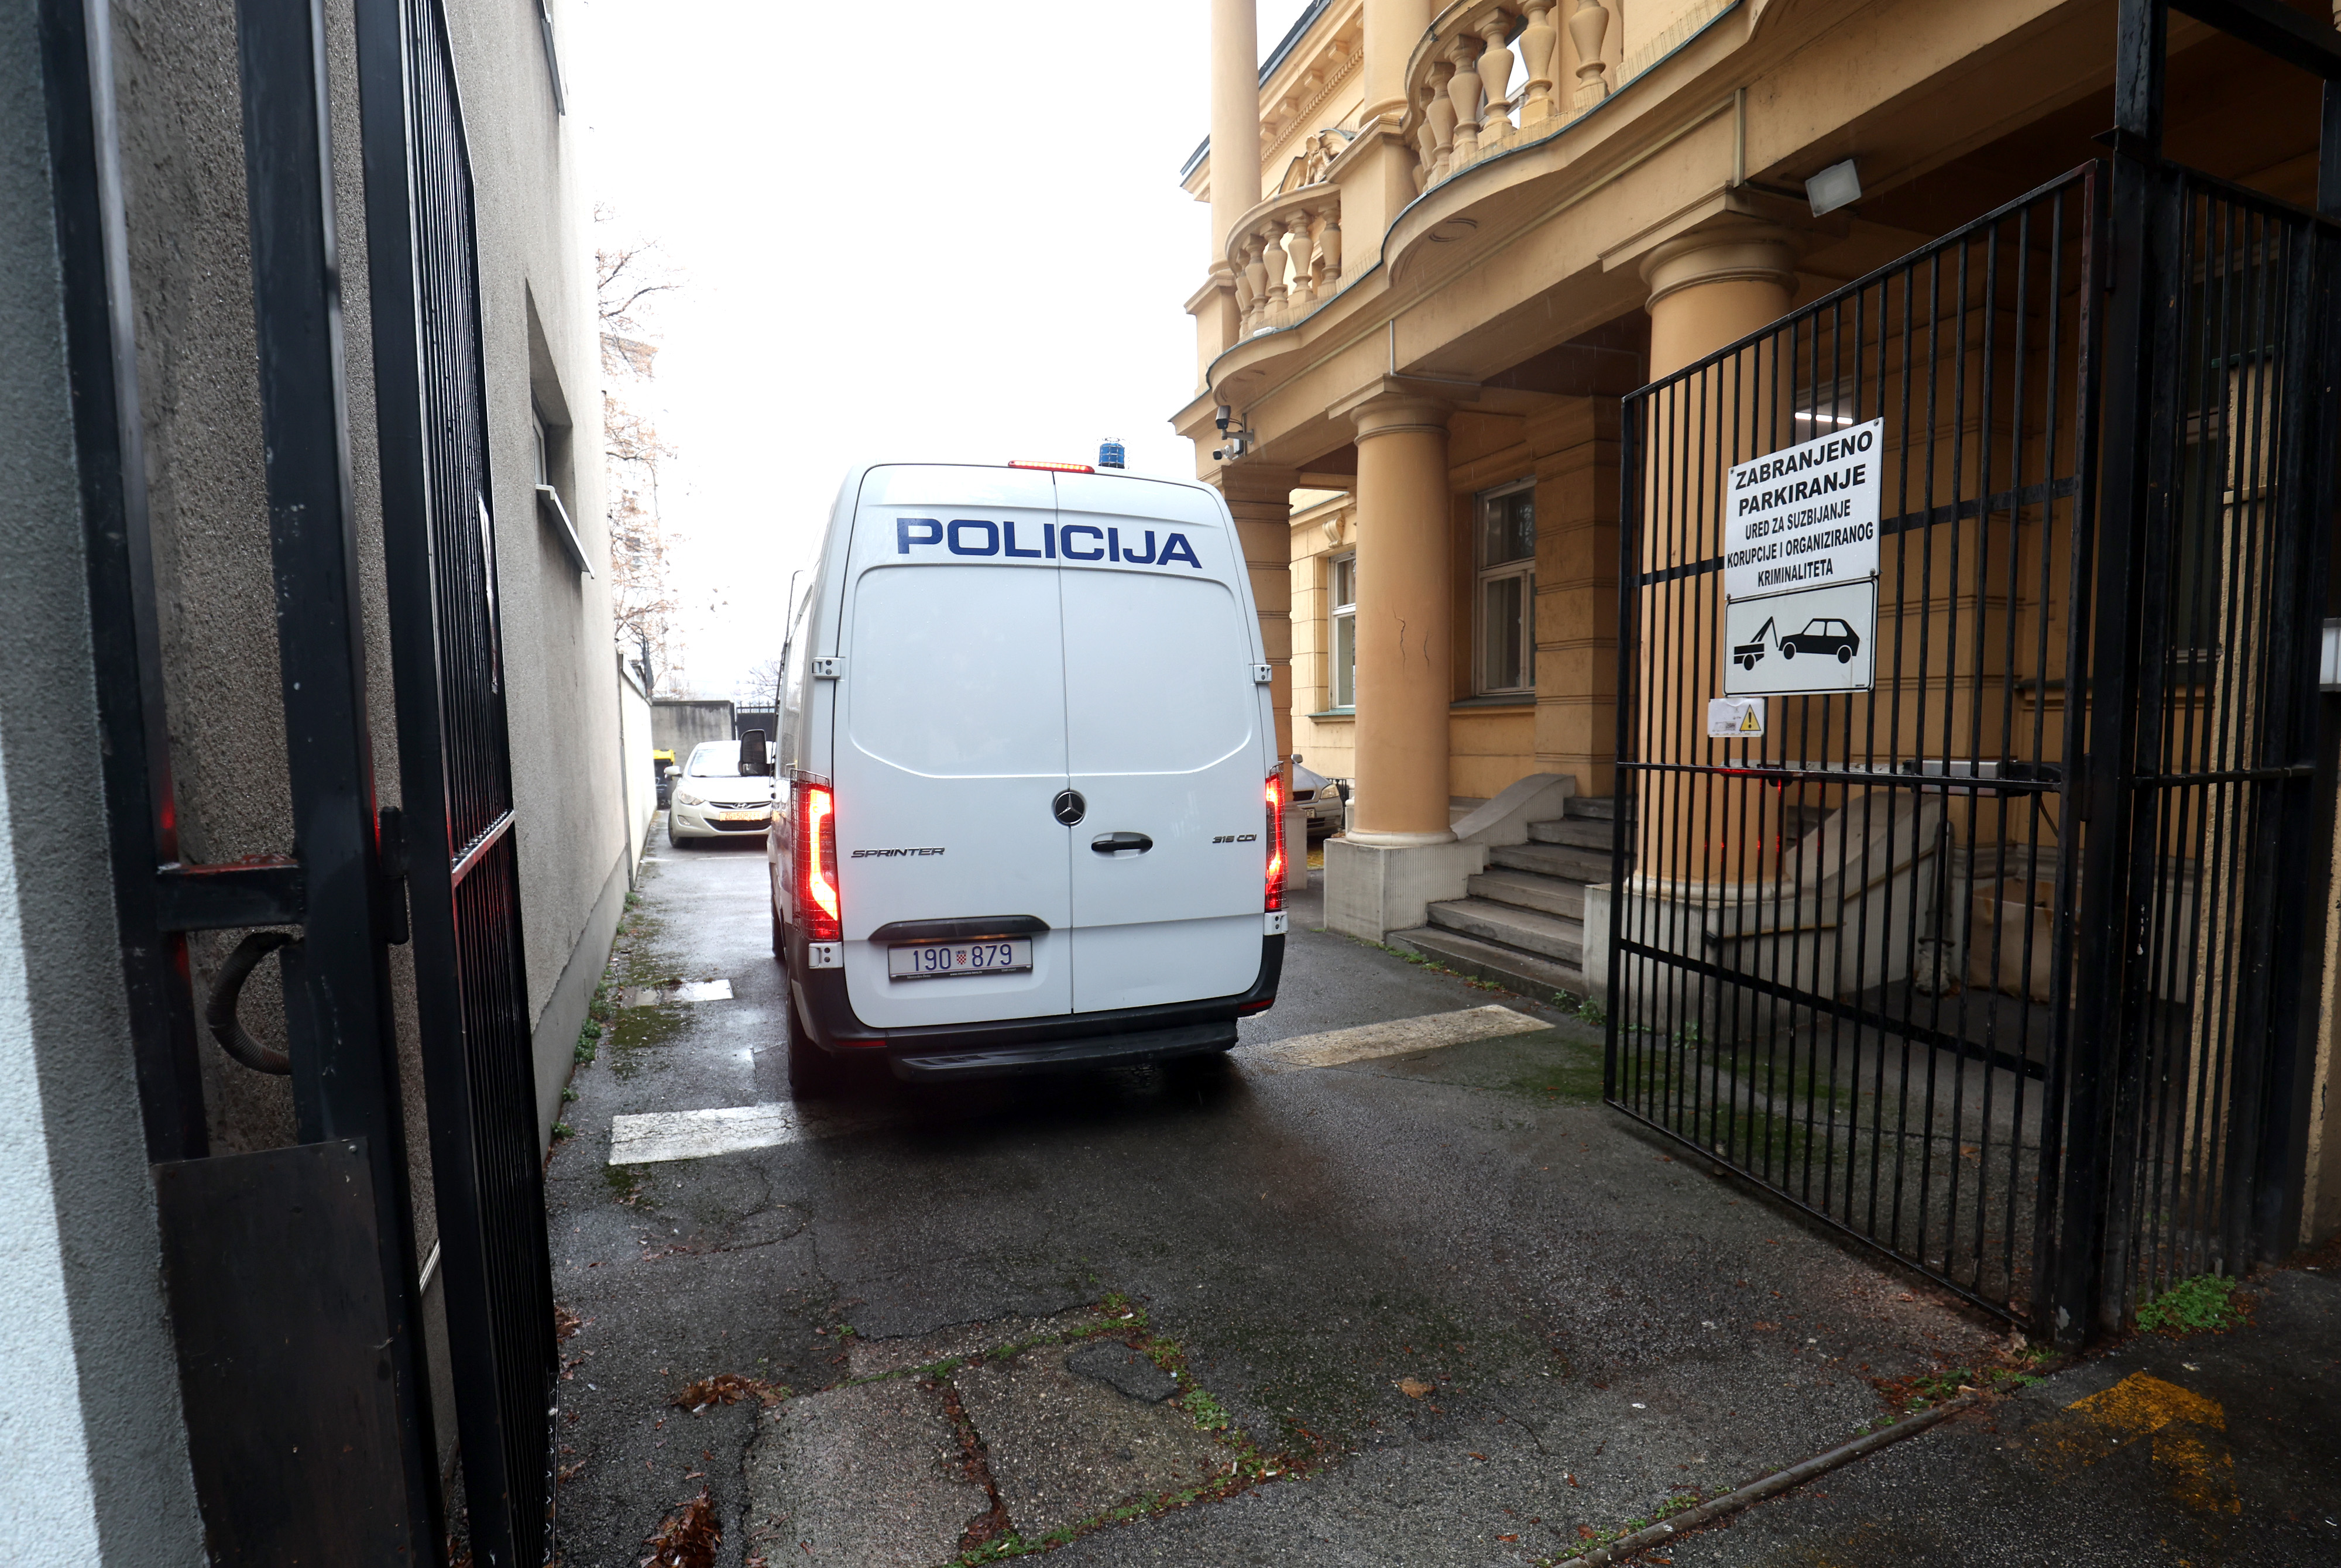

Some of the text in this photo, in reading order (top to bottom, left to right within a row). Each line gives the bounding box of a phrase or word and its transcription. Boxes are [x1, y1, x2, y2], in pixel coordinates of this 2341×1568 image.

[1735, 431, 1873, 490] ZABRANJENO
[1739, 464, 1866, 517] PARKIRANJE
[1746, 499, 1851, 540] URED ZA SUZBIJANJE
[896, 517, 1203, 569] POLICIJA
[1727, 521, 1873, 568] KORUPCIJE I ORGANIZIRANOG
[1758, 558, 1833, 587] KRIMINALITETA
[851, 846, 945, 858] SPRINTER
[913, 943, 1012, 972] 190 879
